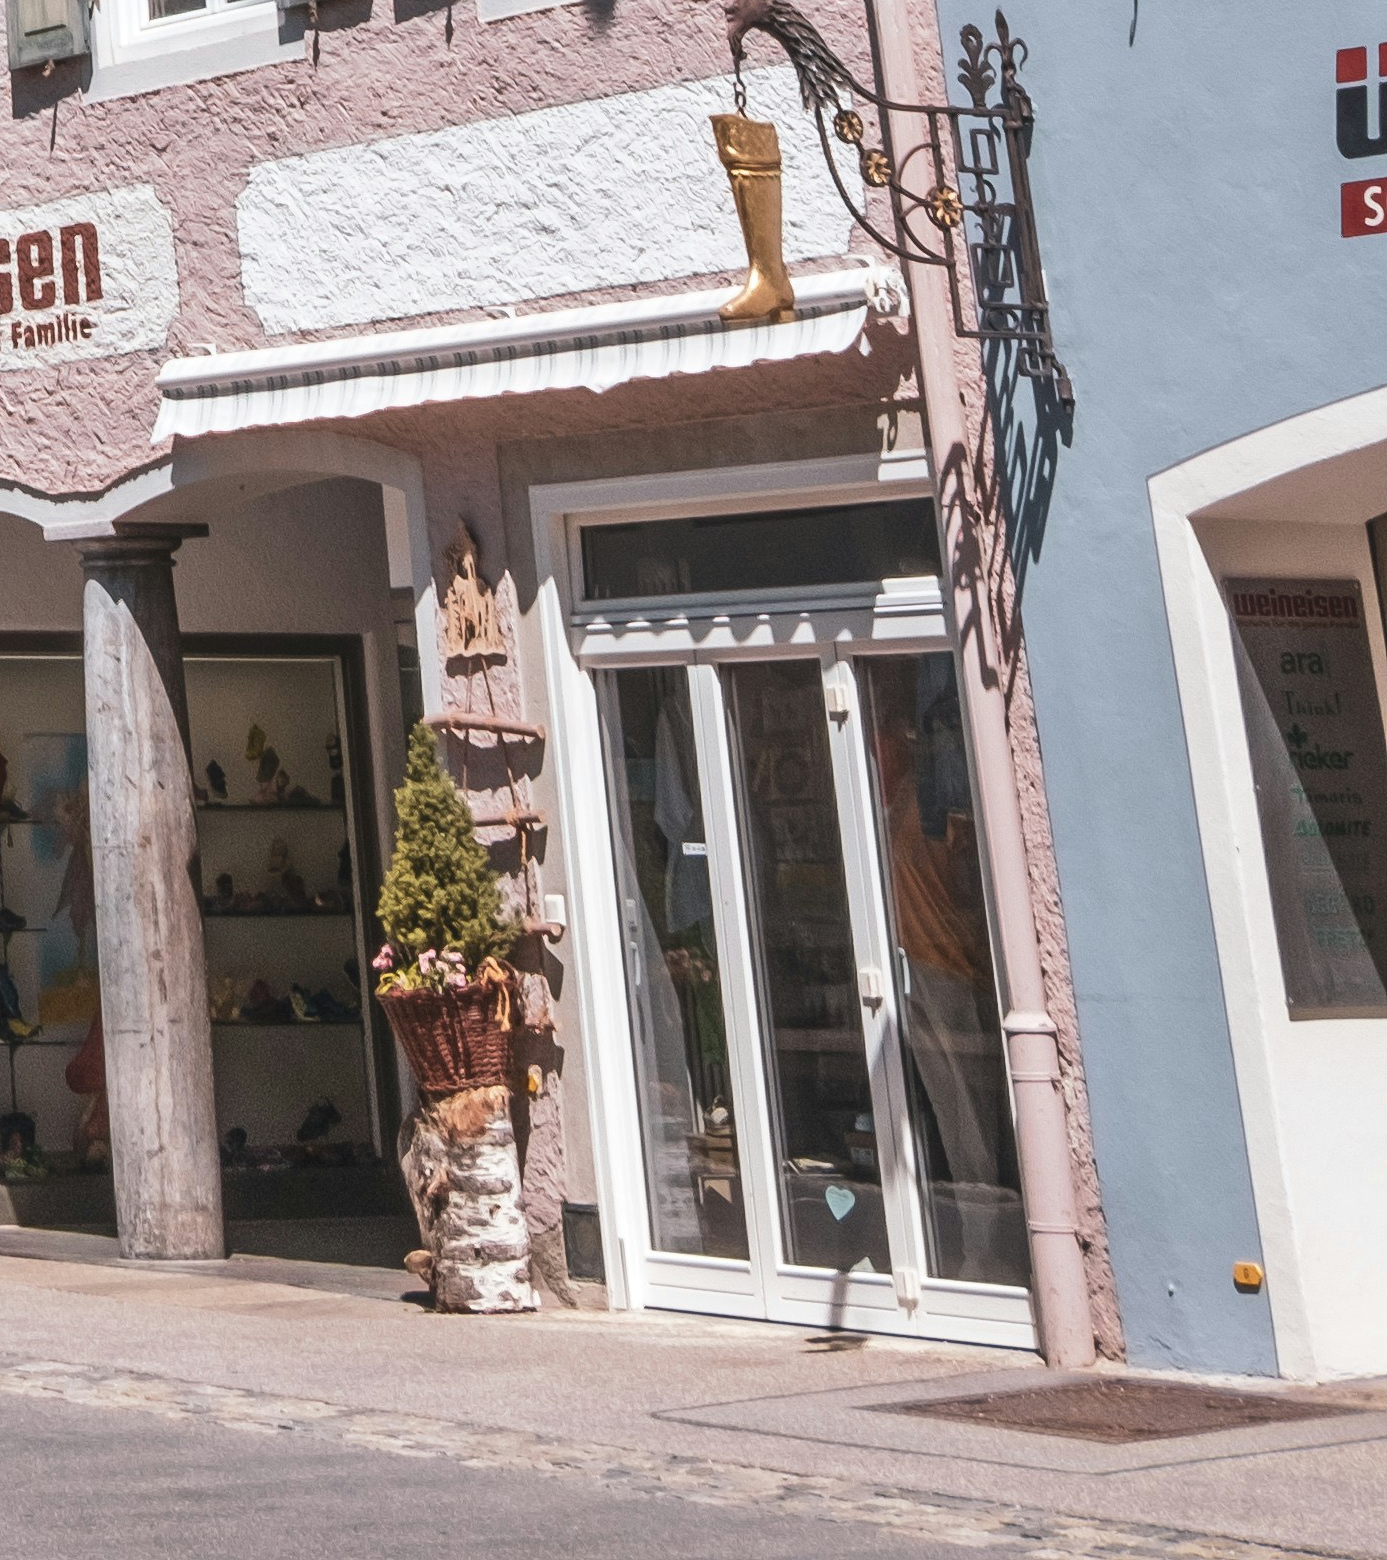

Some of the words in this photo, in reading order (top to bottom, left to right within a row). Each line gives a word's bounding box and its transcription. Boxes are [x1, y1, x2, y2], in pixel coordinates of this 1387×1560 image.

[11, 312, 94, 349] Familie
[1232, 588, 1359, 618] weineisen
[1280, 651, 1324, 675] ara
